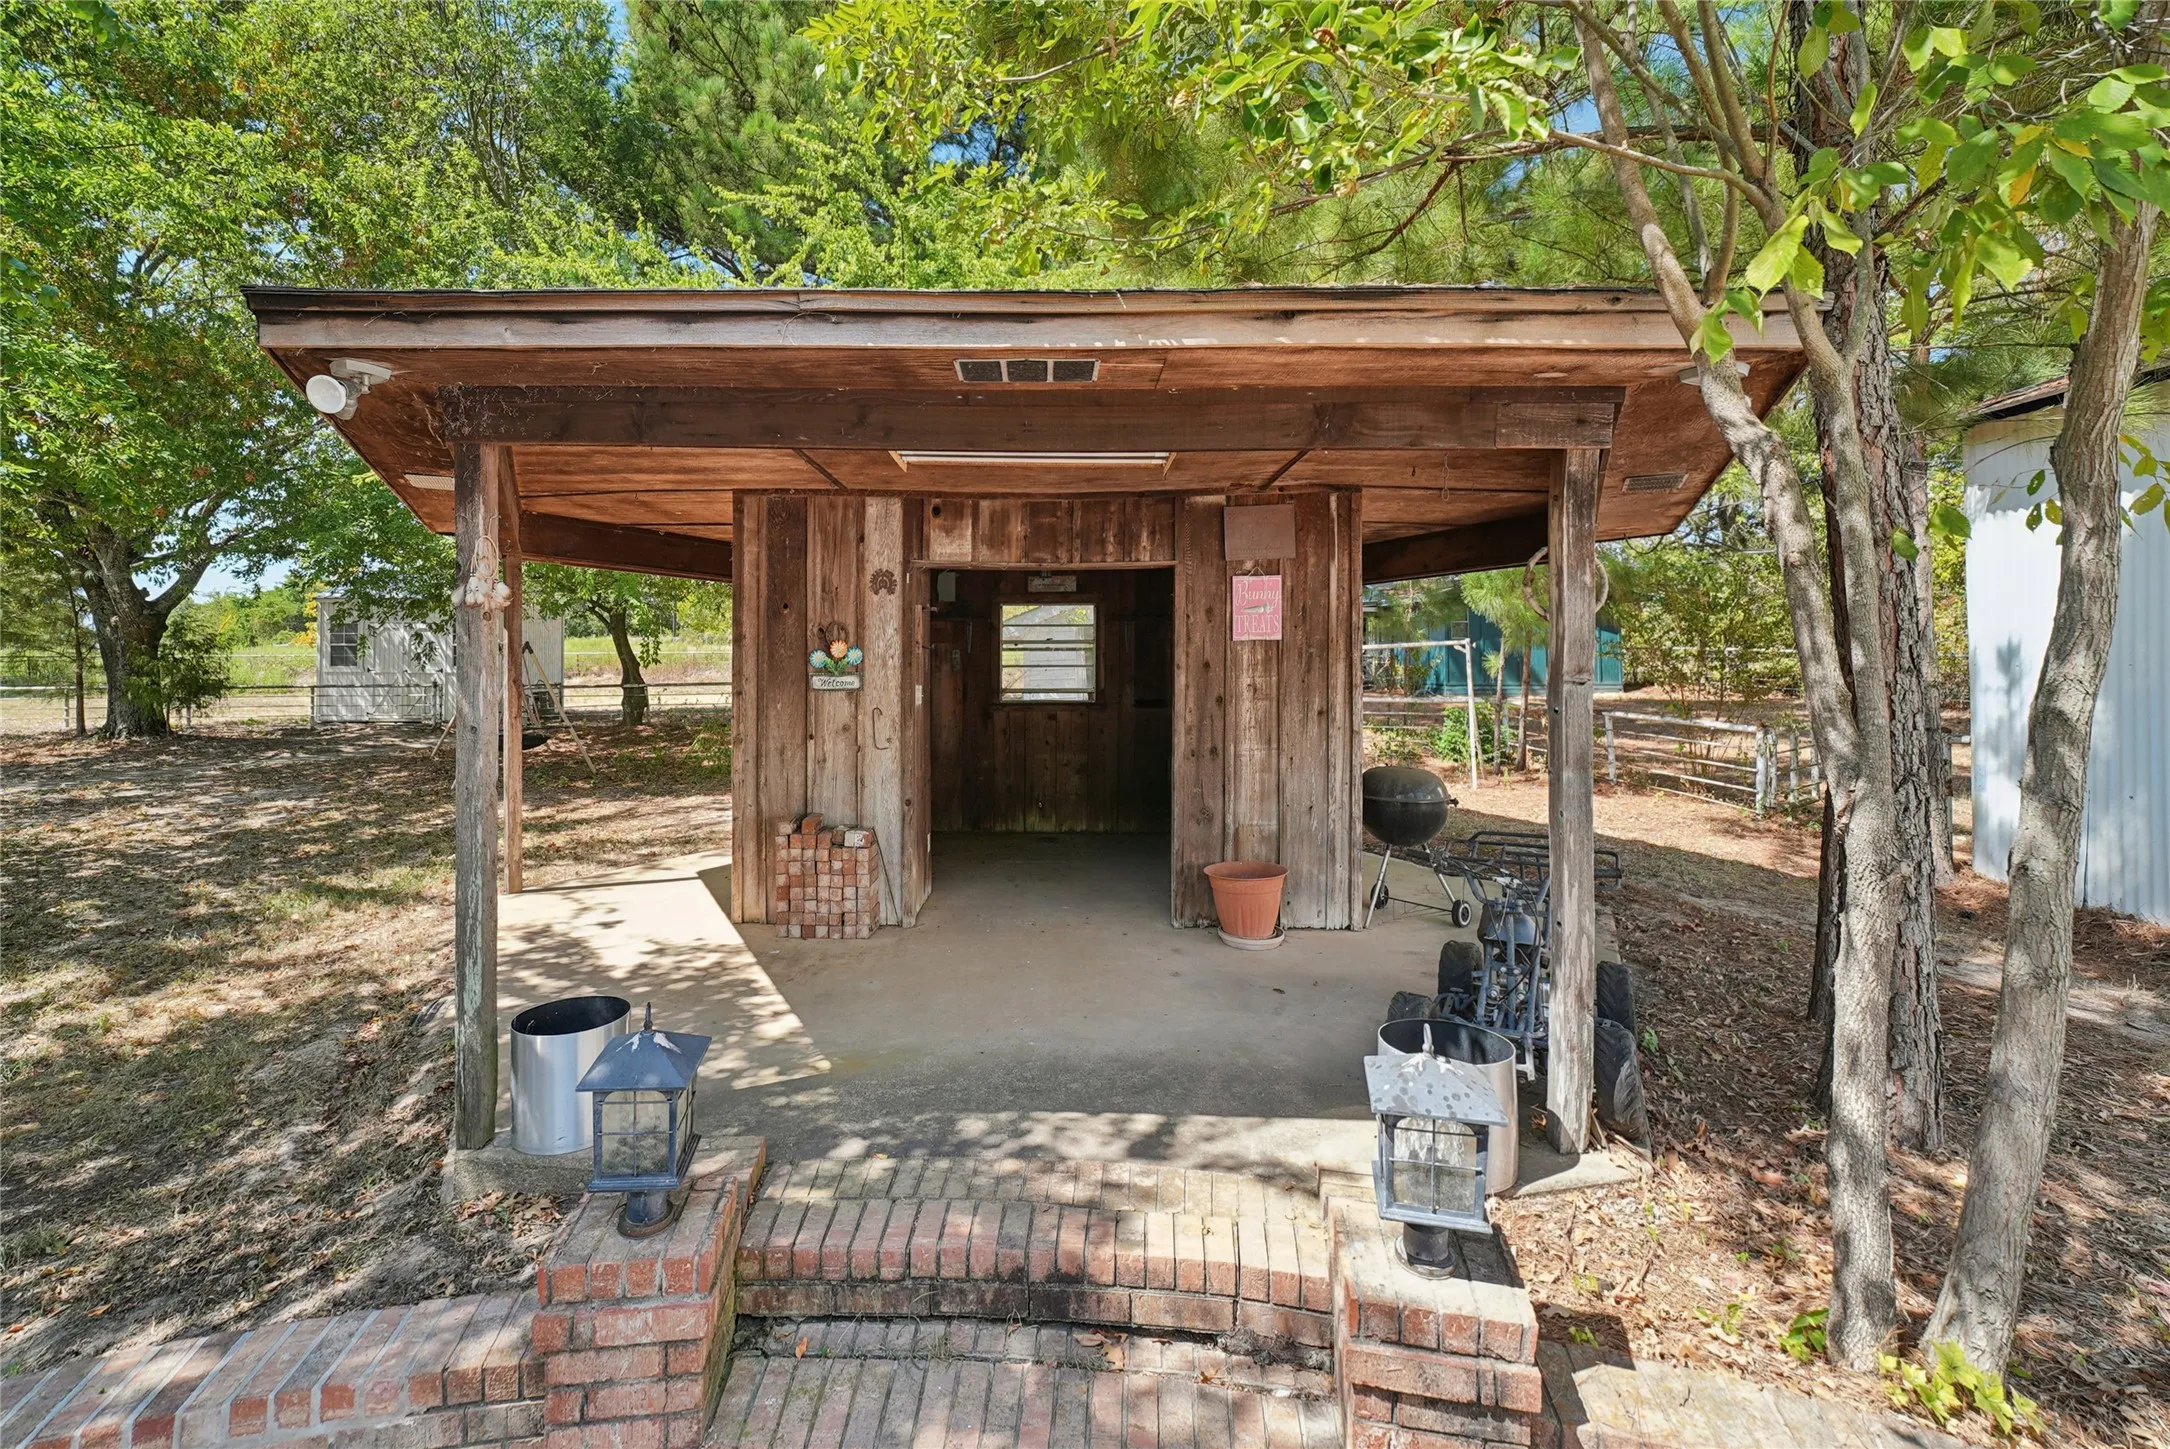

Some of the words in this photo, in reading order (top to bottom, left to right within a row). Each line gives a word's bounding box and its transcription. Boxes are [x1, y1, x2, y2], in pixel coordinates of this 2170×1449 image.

[1236, 580, 1280, 608] Bunny
[1235, 614, 1279, 633] TREATS
[818, 677, 855, 687] Welcome
